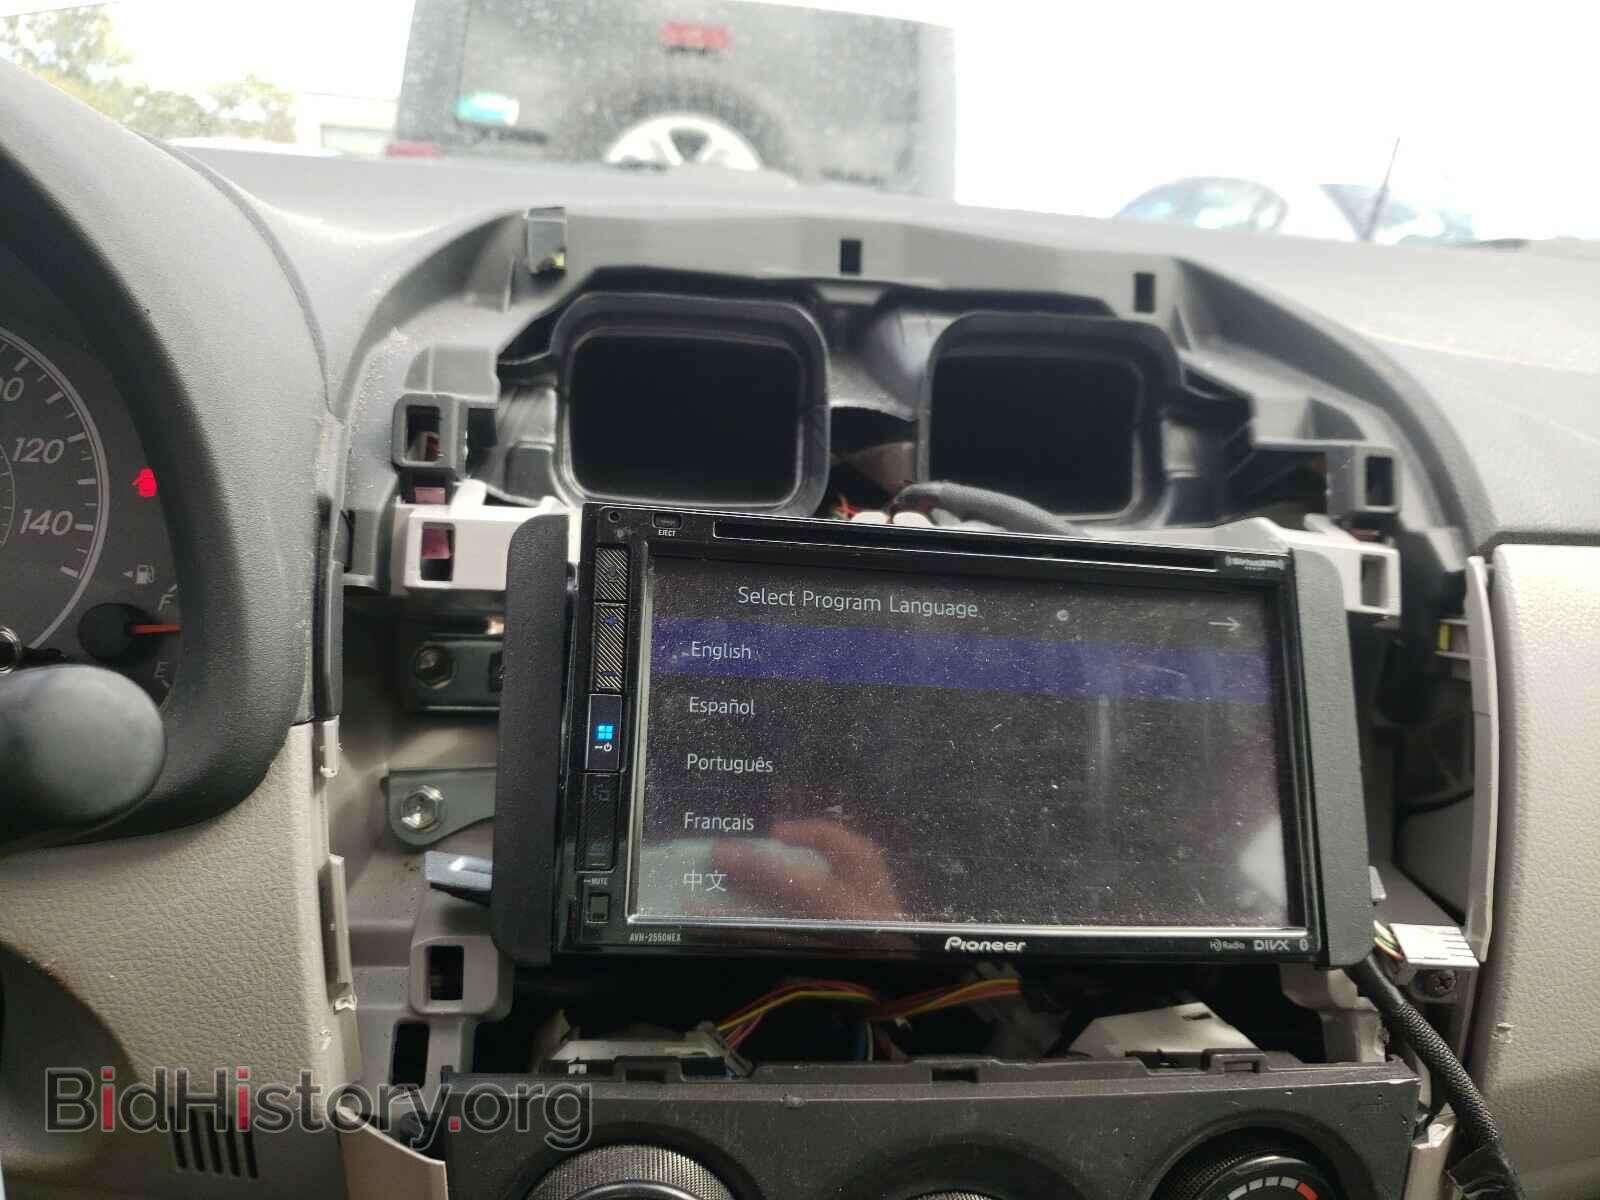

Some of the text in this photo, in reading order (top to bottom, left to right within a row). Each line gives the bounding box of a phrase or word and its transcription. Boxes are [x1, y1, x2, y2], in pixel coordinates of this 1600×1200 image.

[12, 437, 65, 464] 120
[19, 509, 73, 536] 140
[658, 529, 676, 537] EJECT
[737, 586, 979, 619] Select Program Language
[691, 641, 752, 660] English
[688, 696, 756, 716] Español
[686, 753, 774, 774] Português
[683, 812, 755, 833] Français
[683, 870, 728, 893] 中文
[944, 936, 1026, 951] Pioneer
